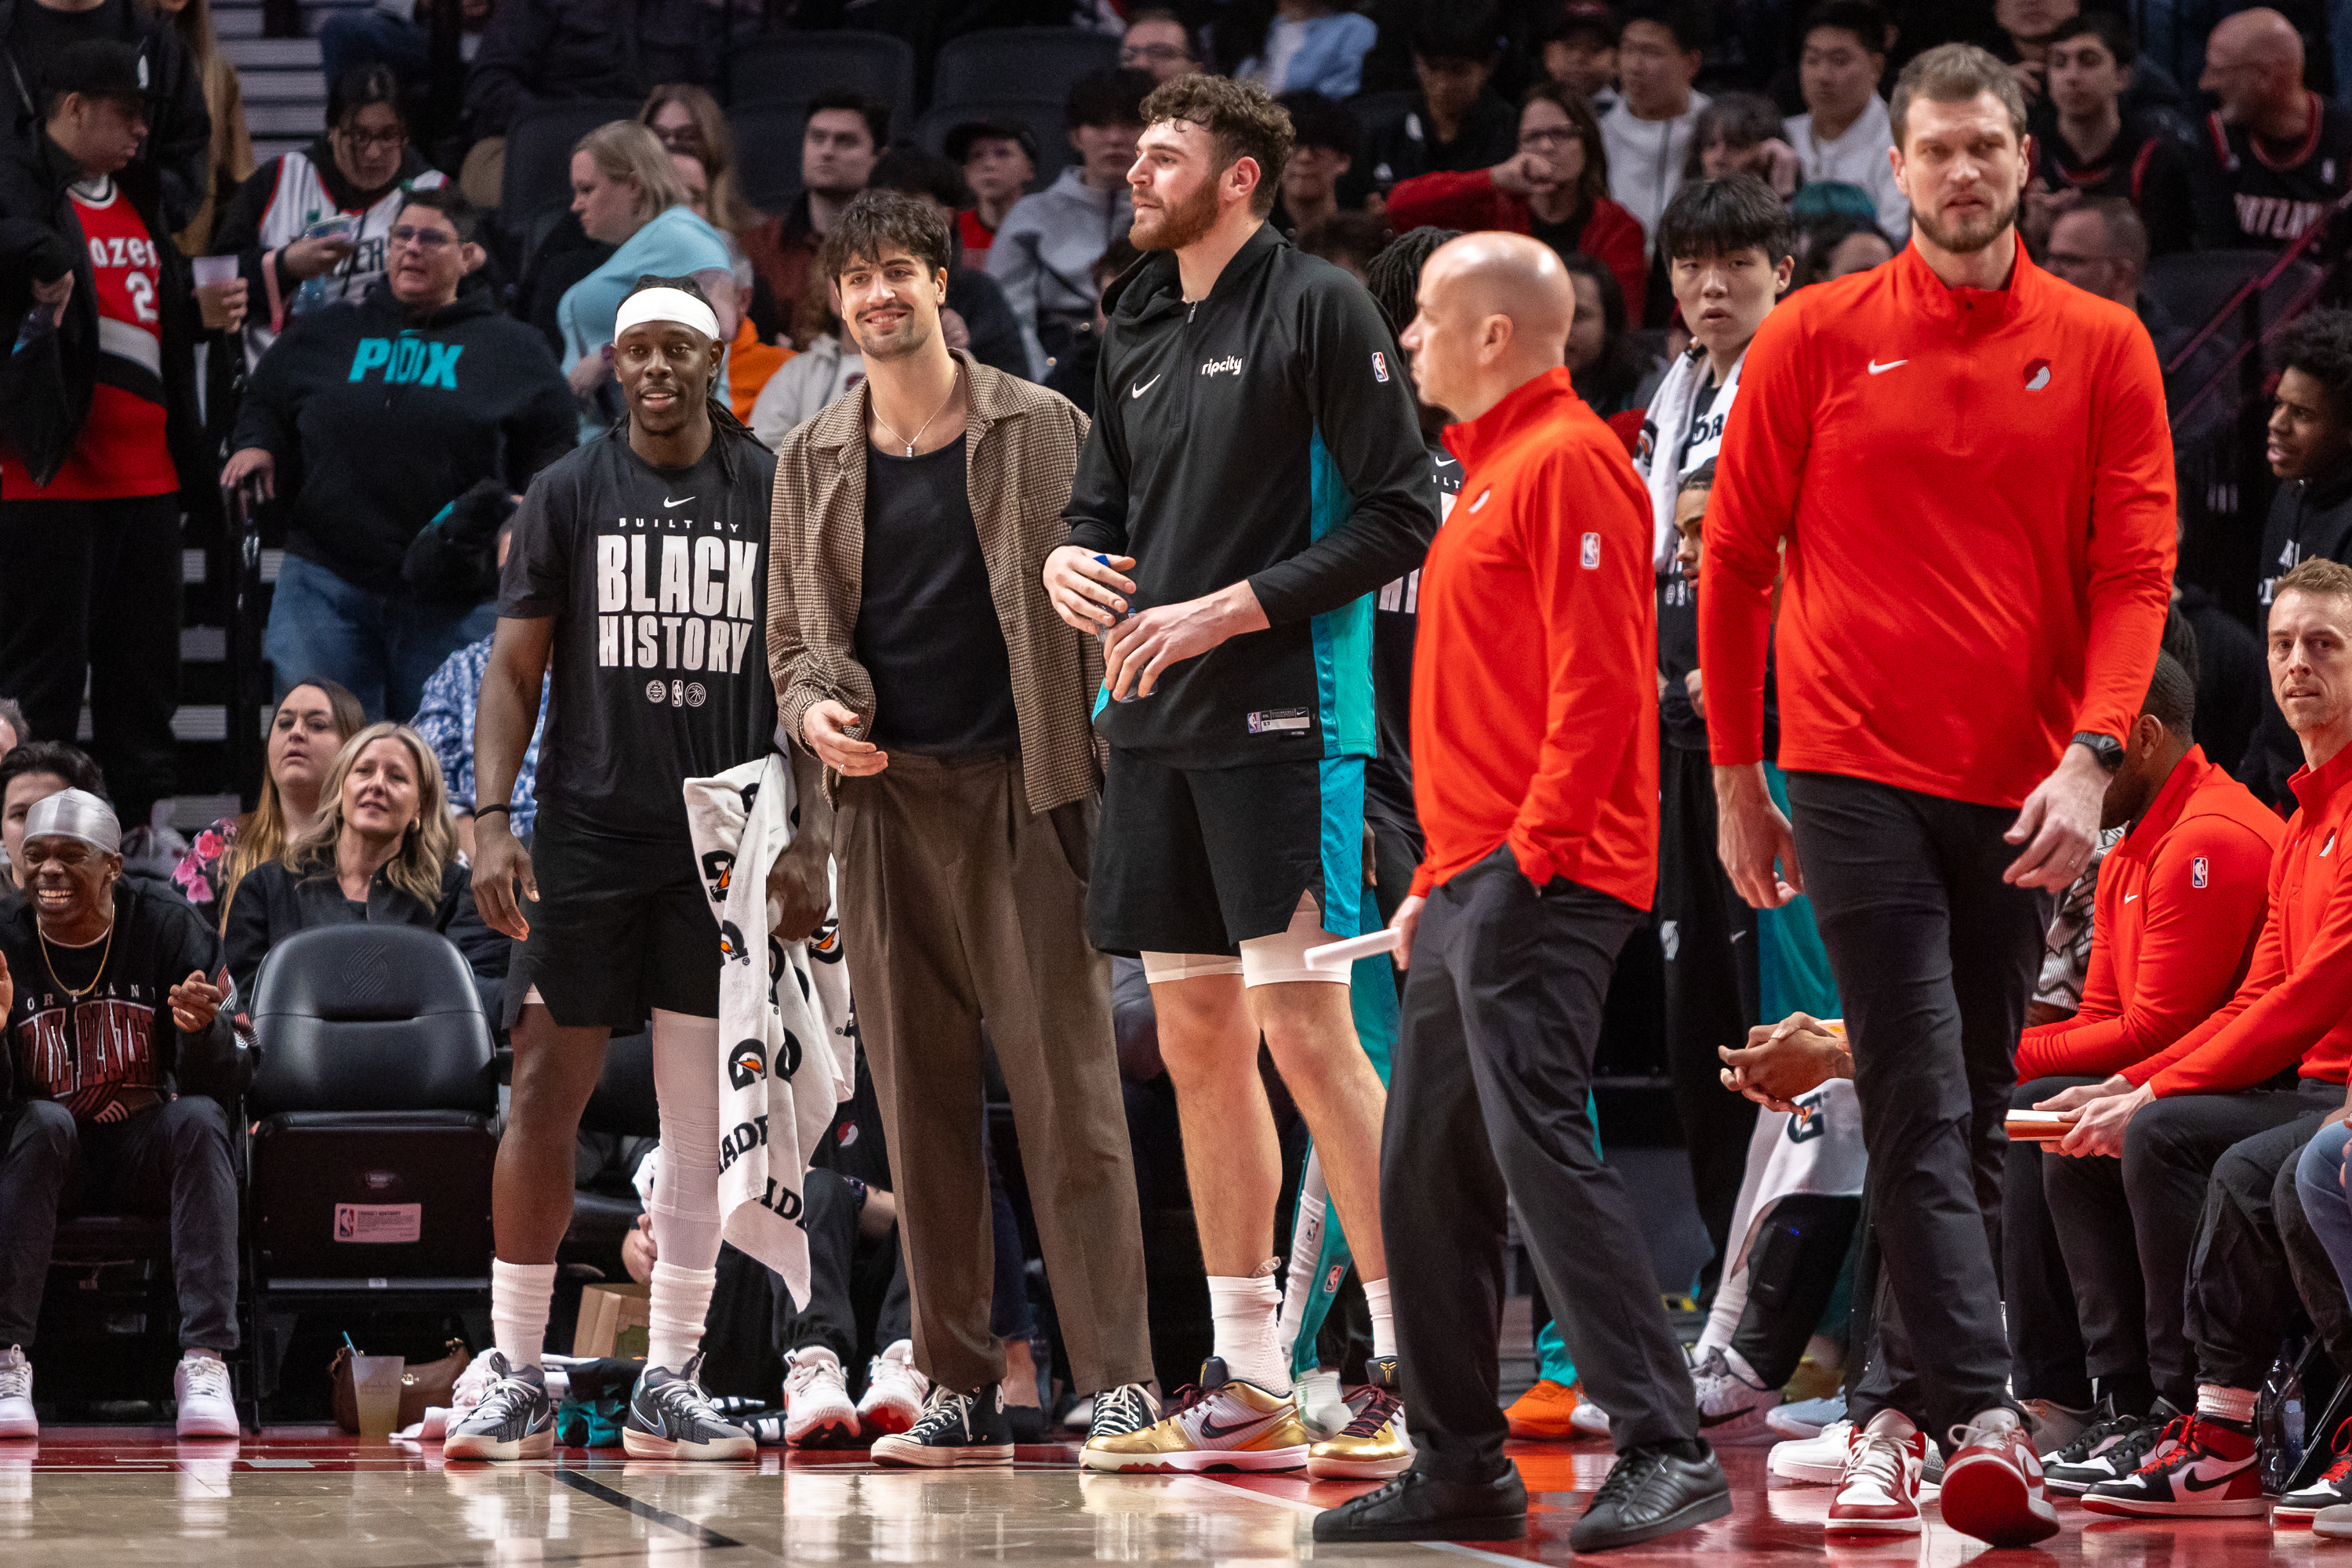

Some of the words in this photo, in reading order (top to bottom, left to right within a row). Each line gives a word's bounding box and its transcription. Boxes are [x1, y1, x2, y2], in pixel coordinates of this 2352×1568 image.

[1201, 354, 1243, 378] ripcity
[1432, 474, 1461, 490] ILT
[619, 517, 693, 529] BUILT
[713, 521, 739, 533] BY
[597, 533, 759, 621] BLACK
[597, 614, 753, 675] HISTORY
[11, 982, 155, 1012] ORTLAN
